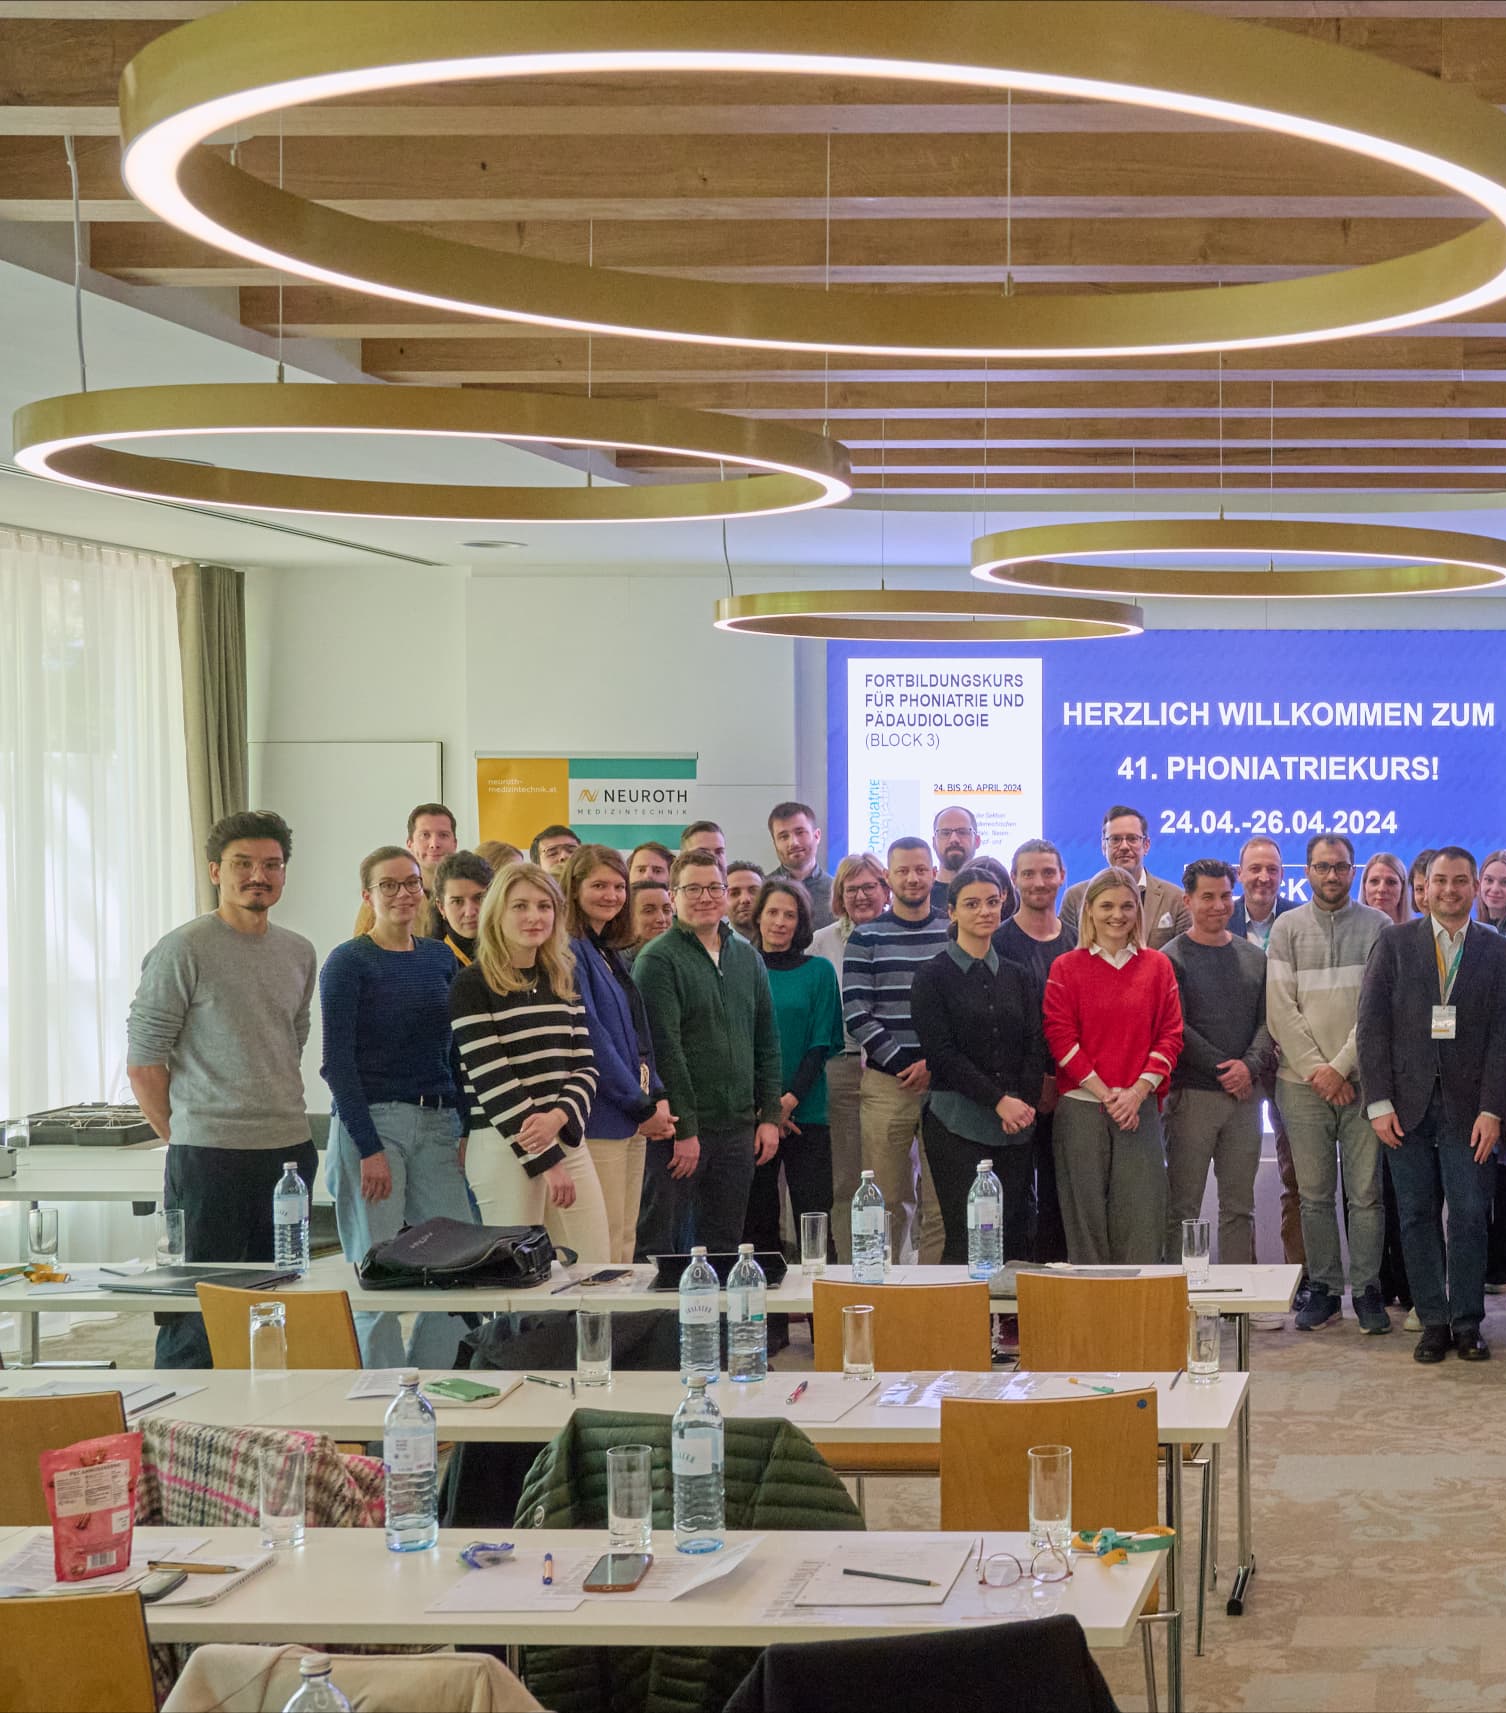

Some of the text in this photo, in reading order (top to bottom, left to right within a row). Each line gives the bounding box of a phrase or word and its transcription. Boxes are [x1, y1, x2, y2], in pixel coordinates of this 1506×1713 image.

[865, 674, 1024, 687] FORTBILDUNGSKURS
[865, 690, 1024, 707] FÜR PHONIATRIE UND
[865, 710, 989, 727] PÄDAUDIOLOGIE
[1063, 701, 1495, 727] HERZLICH WILLKOMMEN ZUM
[865, 733, 940, 750] (BLOCK 3)
[1117, 756, 1439, 781] 41. PHONIATRIEKURS!
[604, 789, 688, 803] NEUROTH
[933, 784, 1022, 792] 24. BIS 26. APRIL 2024
[577, 808, 688, 816] MEDIZINTECHNIK
[1160, 810, 1398, 835] 24.04.-26.04.2024
